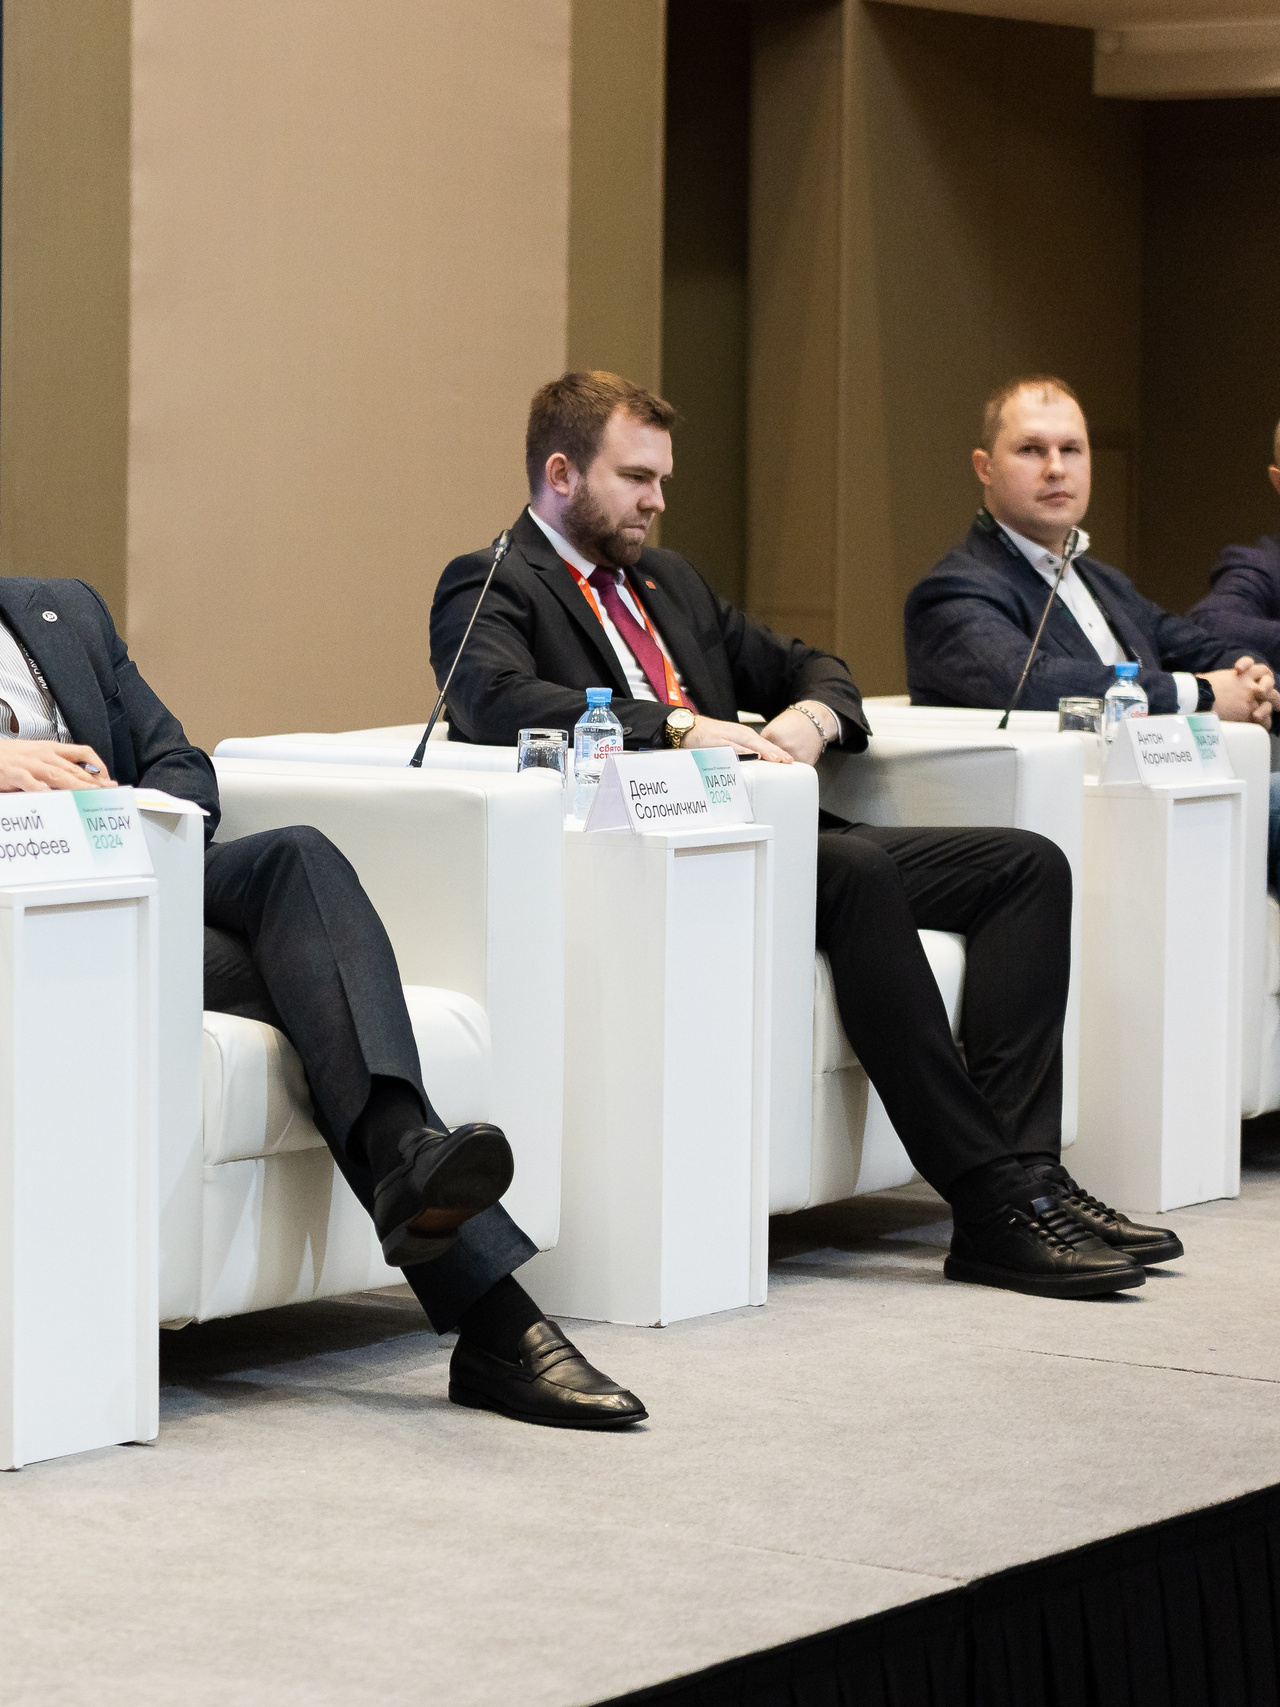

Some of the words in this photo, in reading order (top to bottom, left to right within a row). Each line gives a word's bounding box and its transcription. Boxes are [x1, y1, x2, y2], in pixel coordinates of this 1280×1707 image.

[705, 775, 720, 788] IVA
[720, 773, 737, 787] DAY
[629, 780, 669, 800] Денис
[710, 790, 732, 804] 2024
[634, 800, 708, 820] Солоничкин
[86, 817, 108, 832] IVA
[108, 816, 131, 831] DAY
[93, 834, 124, 850] 2024
